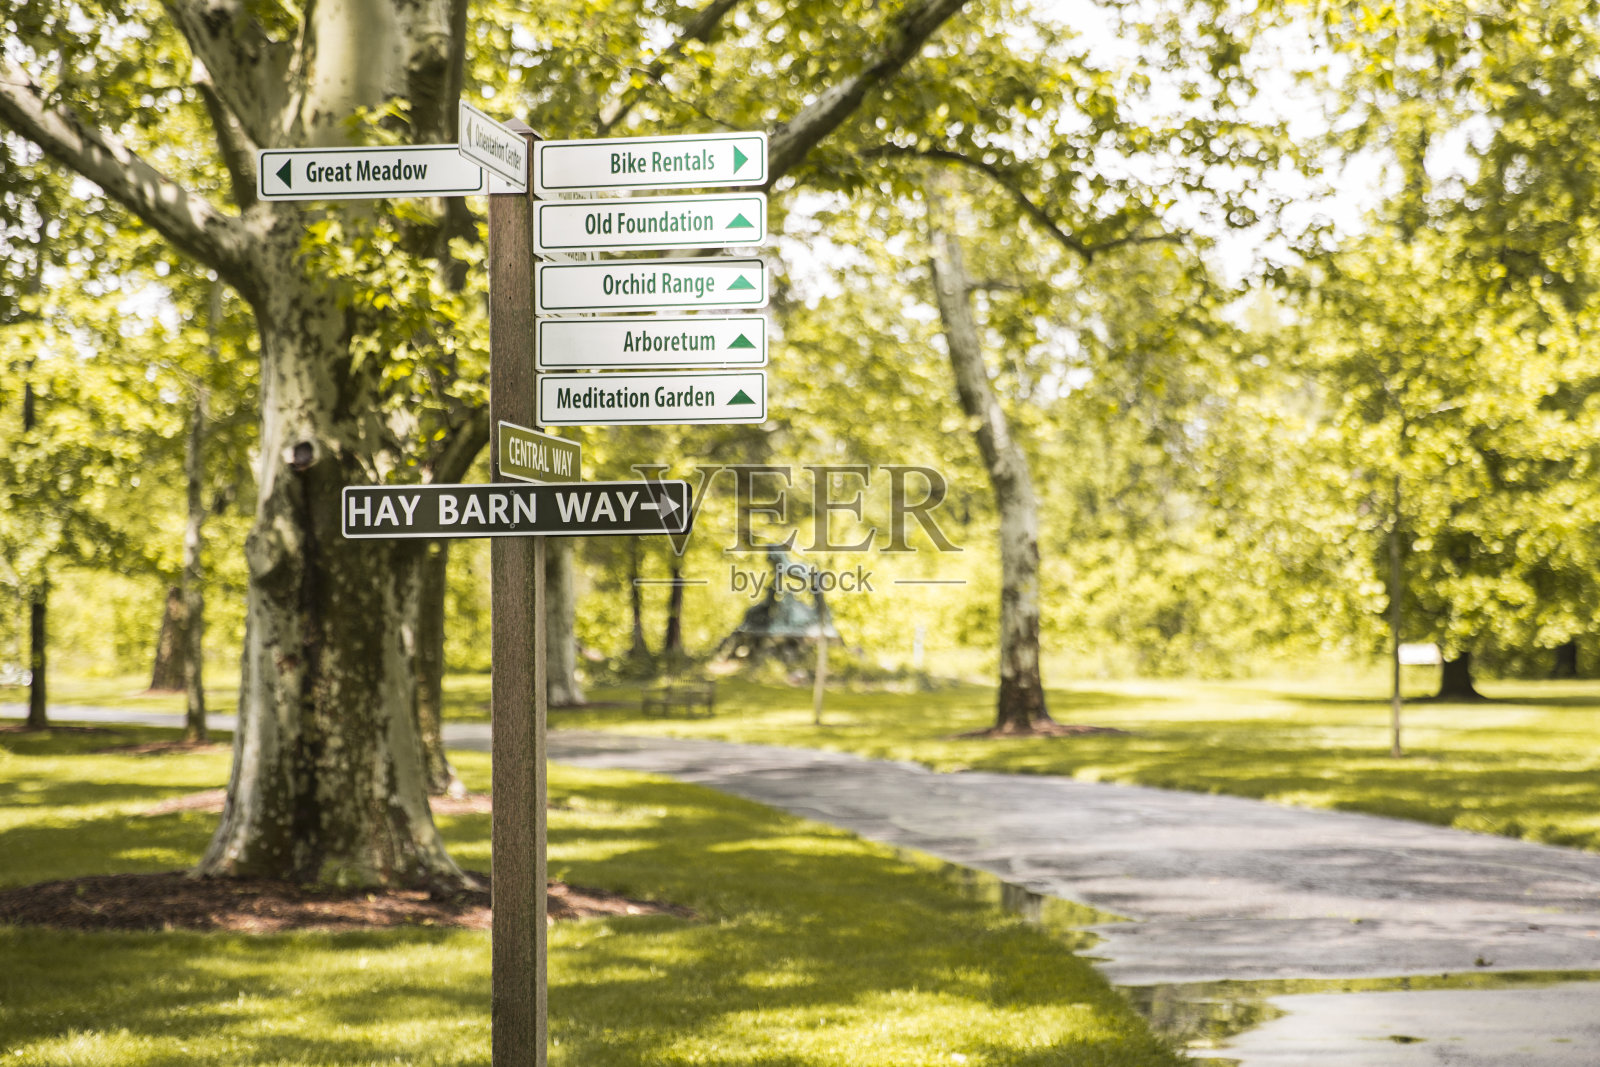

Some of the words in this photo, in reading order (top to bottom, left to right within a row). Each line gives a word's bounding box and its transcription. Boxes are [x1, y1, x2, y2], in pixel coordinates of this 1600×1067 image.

[306, 161, 352, 183] Great
[356, 158, 428, 182] Meadow
[610, 151, 647, 174] Bike
[651, 148, 715, 173] Rentals
[585, 212, 612, 235] Old
[617, 210, 714, 234] Foundation
[603, 272, 656, 295] Orchid
[662, 272, 715, 299] Range
[623, 330, 715, 352] Arboretum
[557, 386, 650, 409] Meditation
[655, 385, 715, 408] Garden
[509, 436, 550, 473] CENTRAL
[552, 447, 573, 477] WAY
[349, 495, 421, 527] HAY
[438, 493, 537, 525] BARN
[555, 491, 639, 523] WAY
